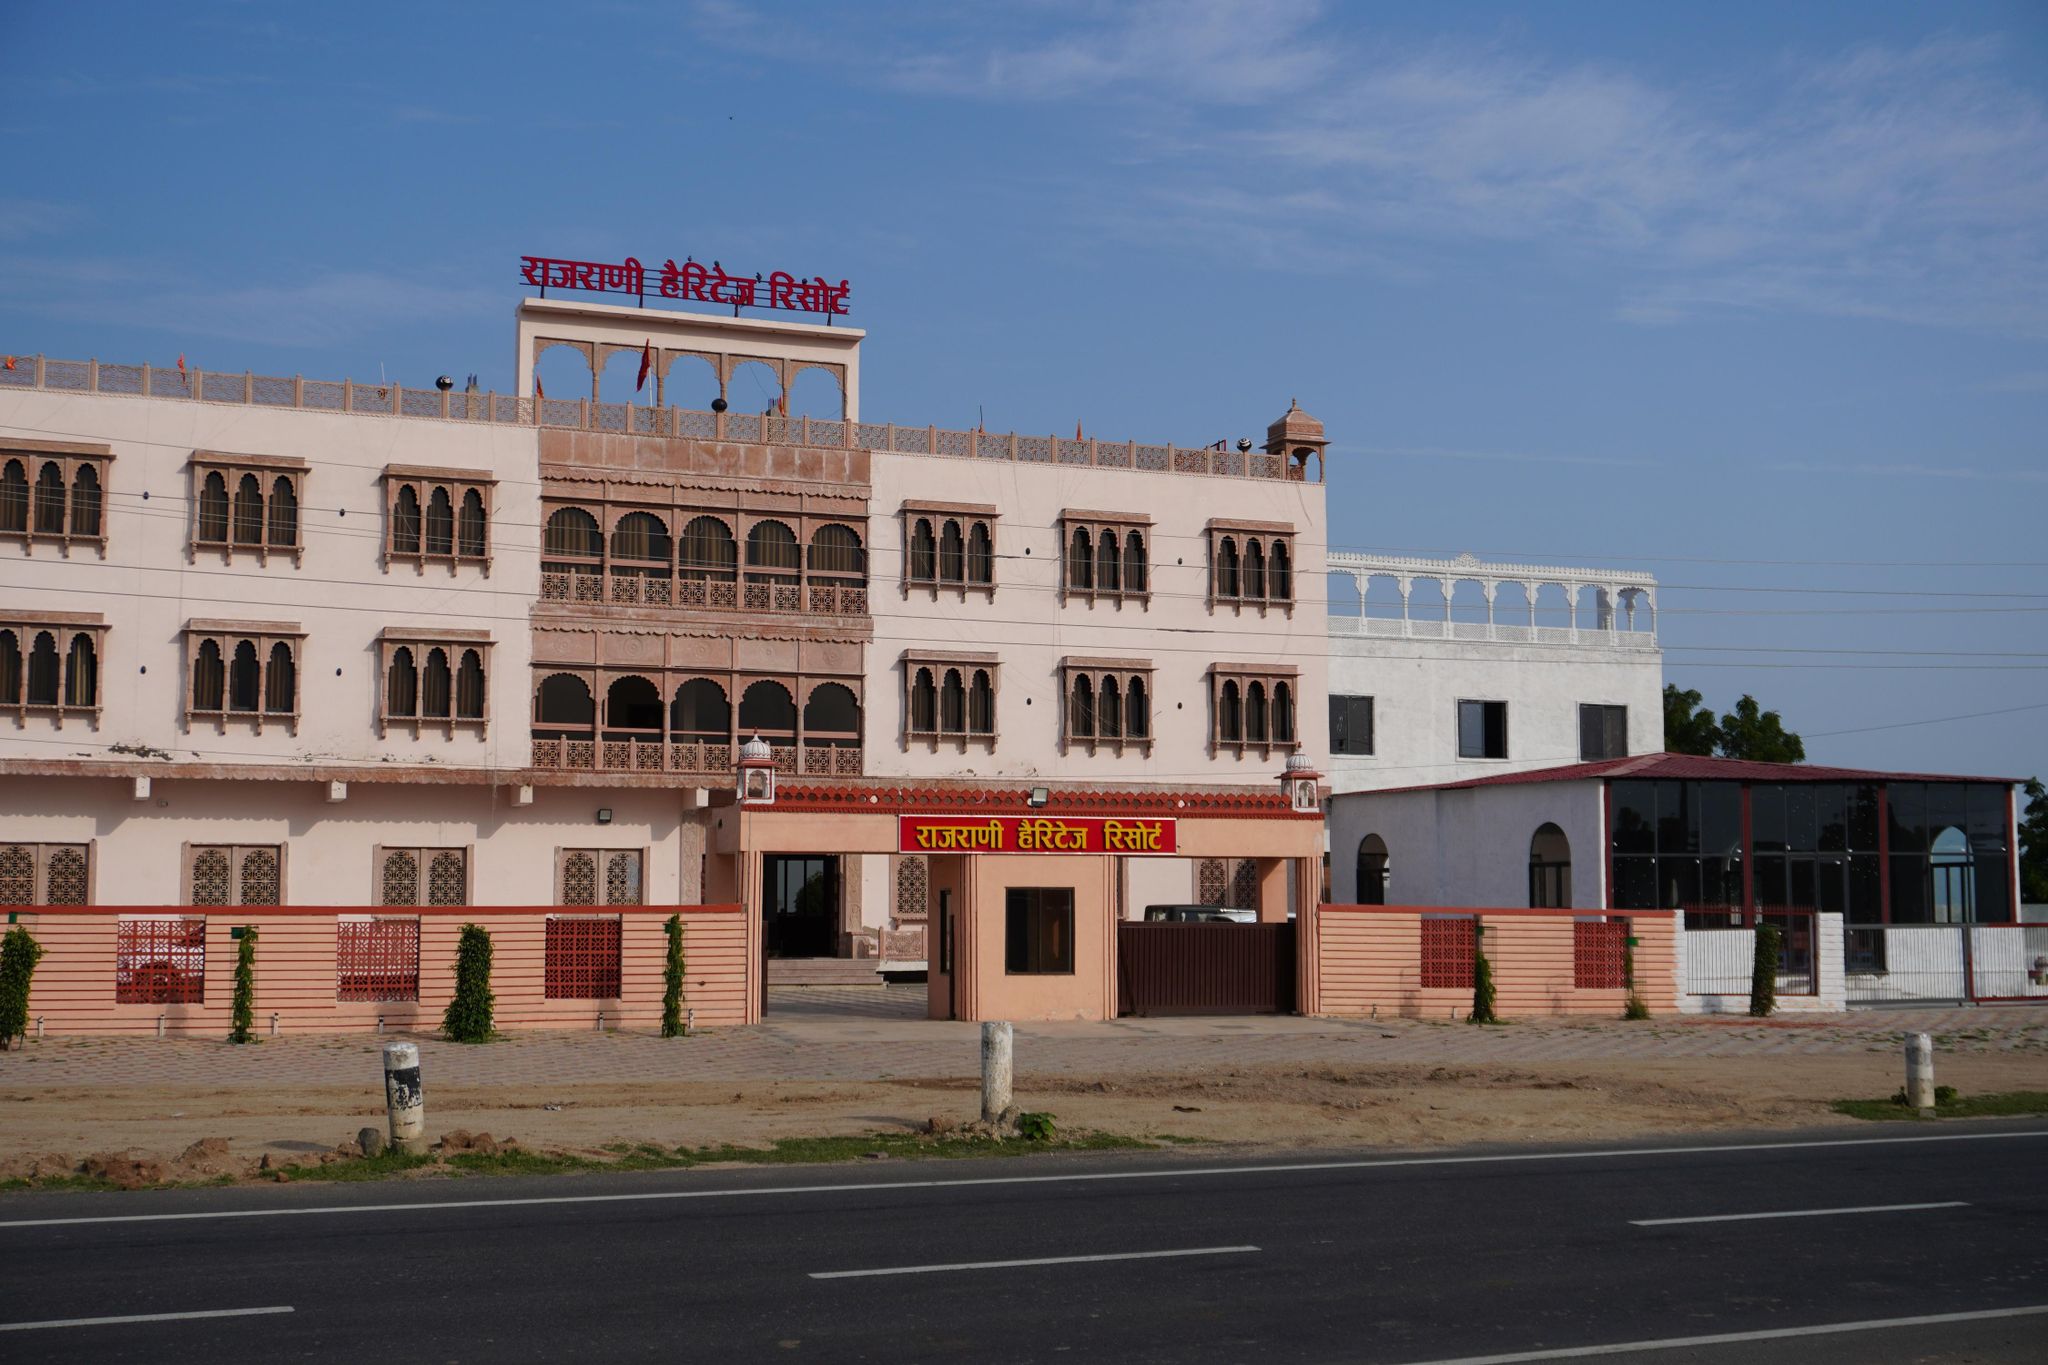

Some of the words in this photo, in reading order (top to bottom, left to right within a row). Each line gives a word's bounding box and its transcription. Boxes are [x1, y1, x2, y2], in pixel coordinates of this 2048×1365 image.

[521, 256, 644, 295] राजराणी
[660, 260, 756, 305] हैरिटेज
[769, 271, 849, 314] रिसोर्ट
[915, 820, 1005, 849] राजराणी
[1018, 819, 1088, 849] हैरिटेज
[1102, 820, 1161, 850] रिसोर्ट
